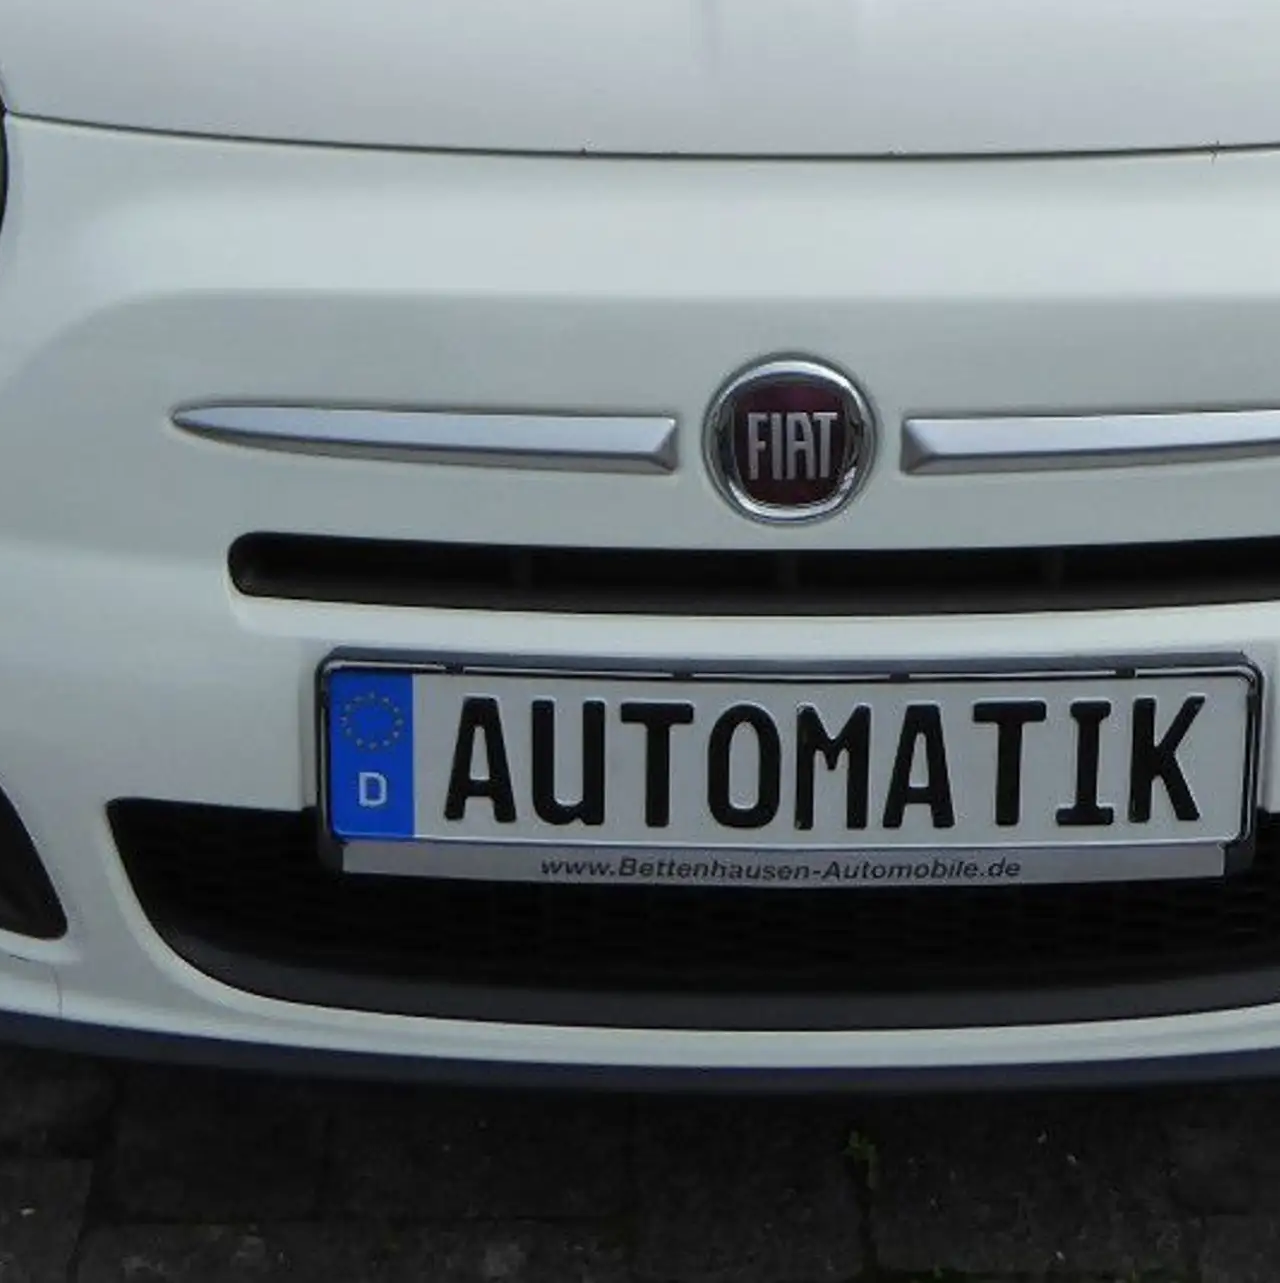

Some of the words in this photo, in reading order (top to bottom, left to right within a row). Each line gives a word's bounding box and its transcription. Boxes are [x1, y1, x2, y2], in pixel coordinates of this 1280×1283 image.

[746, 411, 838, 481] FIAT
[358, 771, 388, 808] D
[443, 695, 1206, 831] AUTOMATIK
[540, 857, 1022, 881] www.Bettenhausen-Automobile.de
